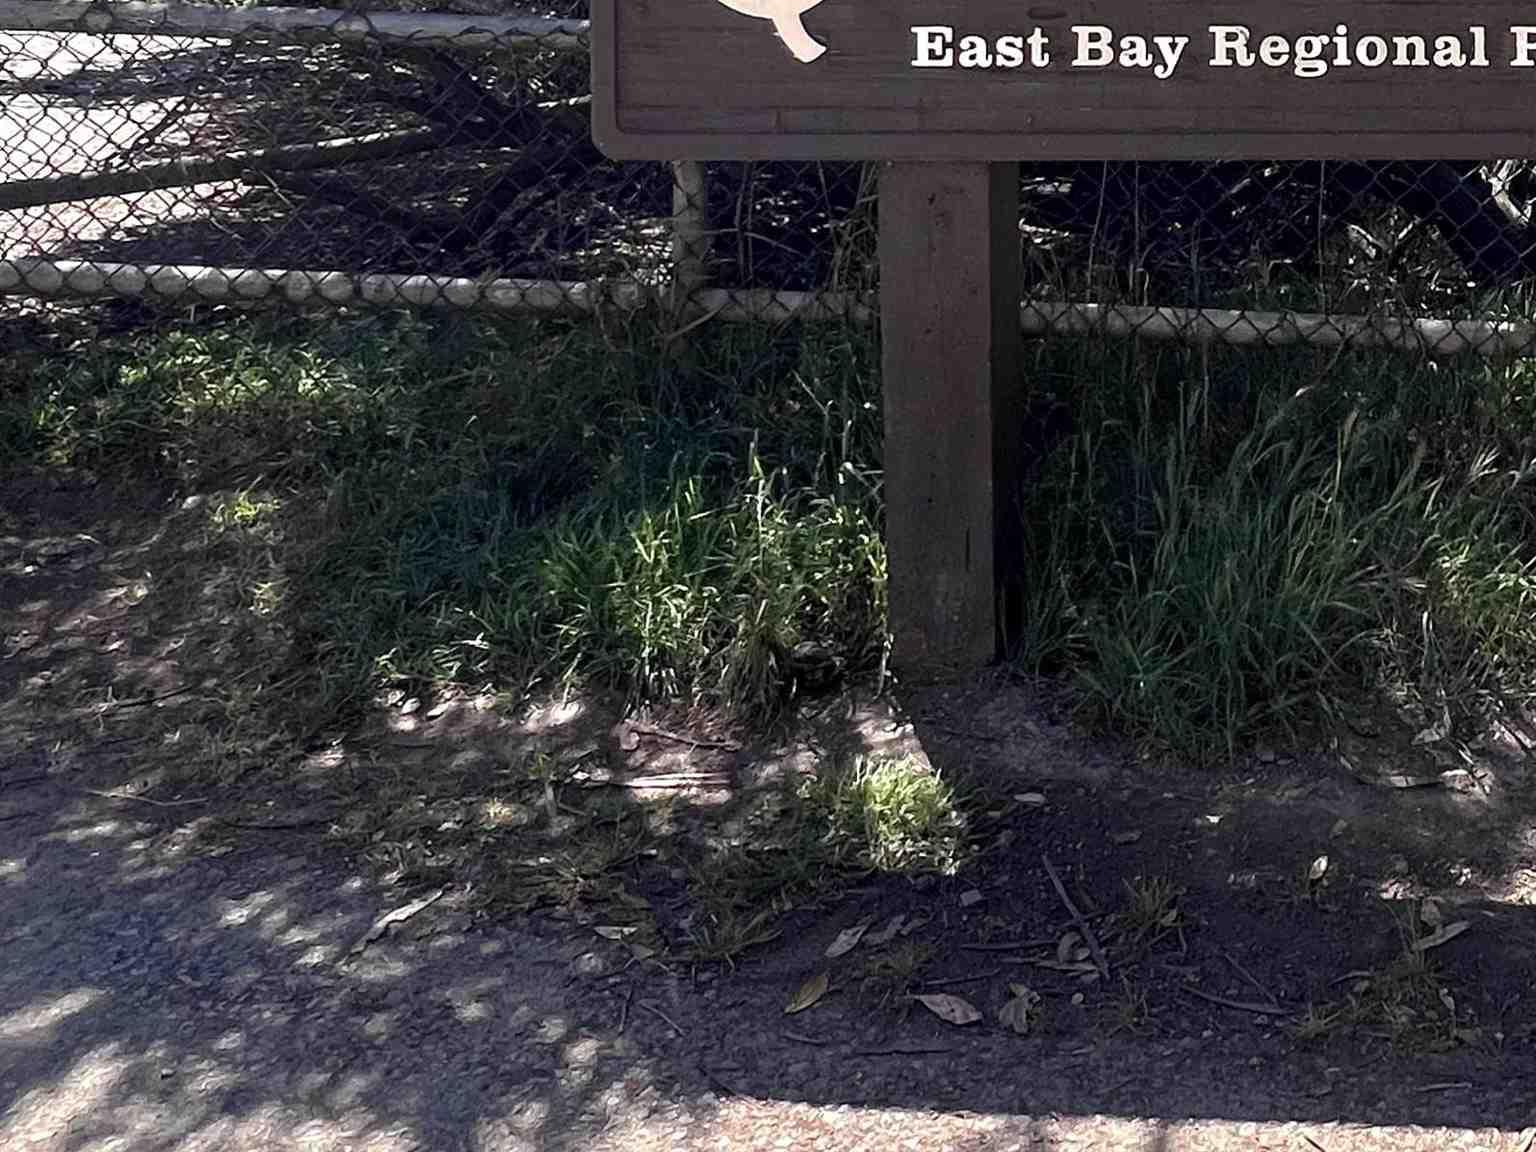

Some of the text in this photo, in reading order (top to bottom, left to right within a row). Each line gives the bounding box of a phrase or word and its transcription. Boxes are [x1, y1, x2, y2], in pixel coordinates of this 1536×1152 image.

[910, 25, 1050, 68] East
[1071, 25, 1189, 79] Bay
[1208, 24, 1490, 78] Regional
